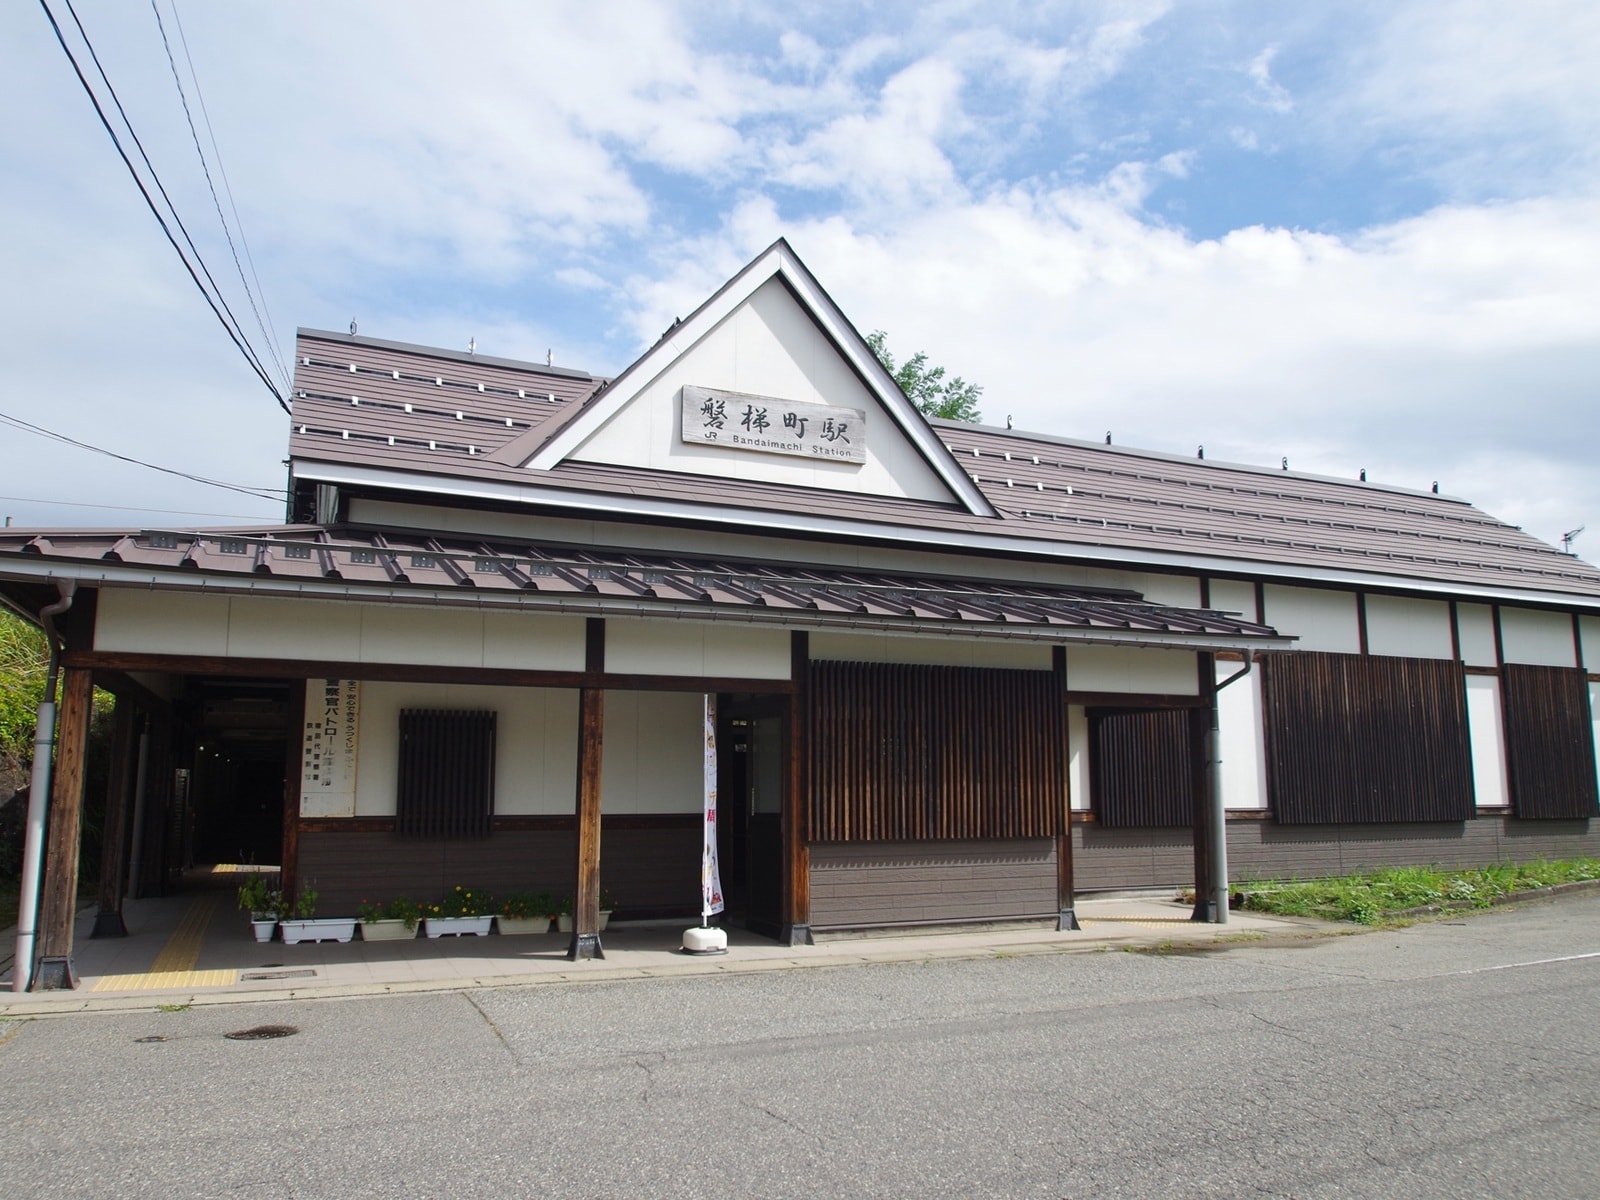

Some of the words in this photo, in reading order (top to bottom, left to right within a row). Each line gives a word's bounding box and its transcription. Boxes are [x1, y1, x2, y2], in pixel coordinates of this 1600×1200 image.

[700, 397, 851, 444] 磐梯町駅
[704, 431, 718, 440] JR
[733, 434, 802, 451] Bandaimachi
[812, 445, 851, 457] Station
